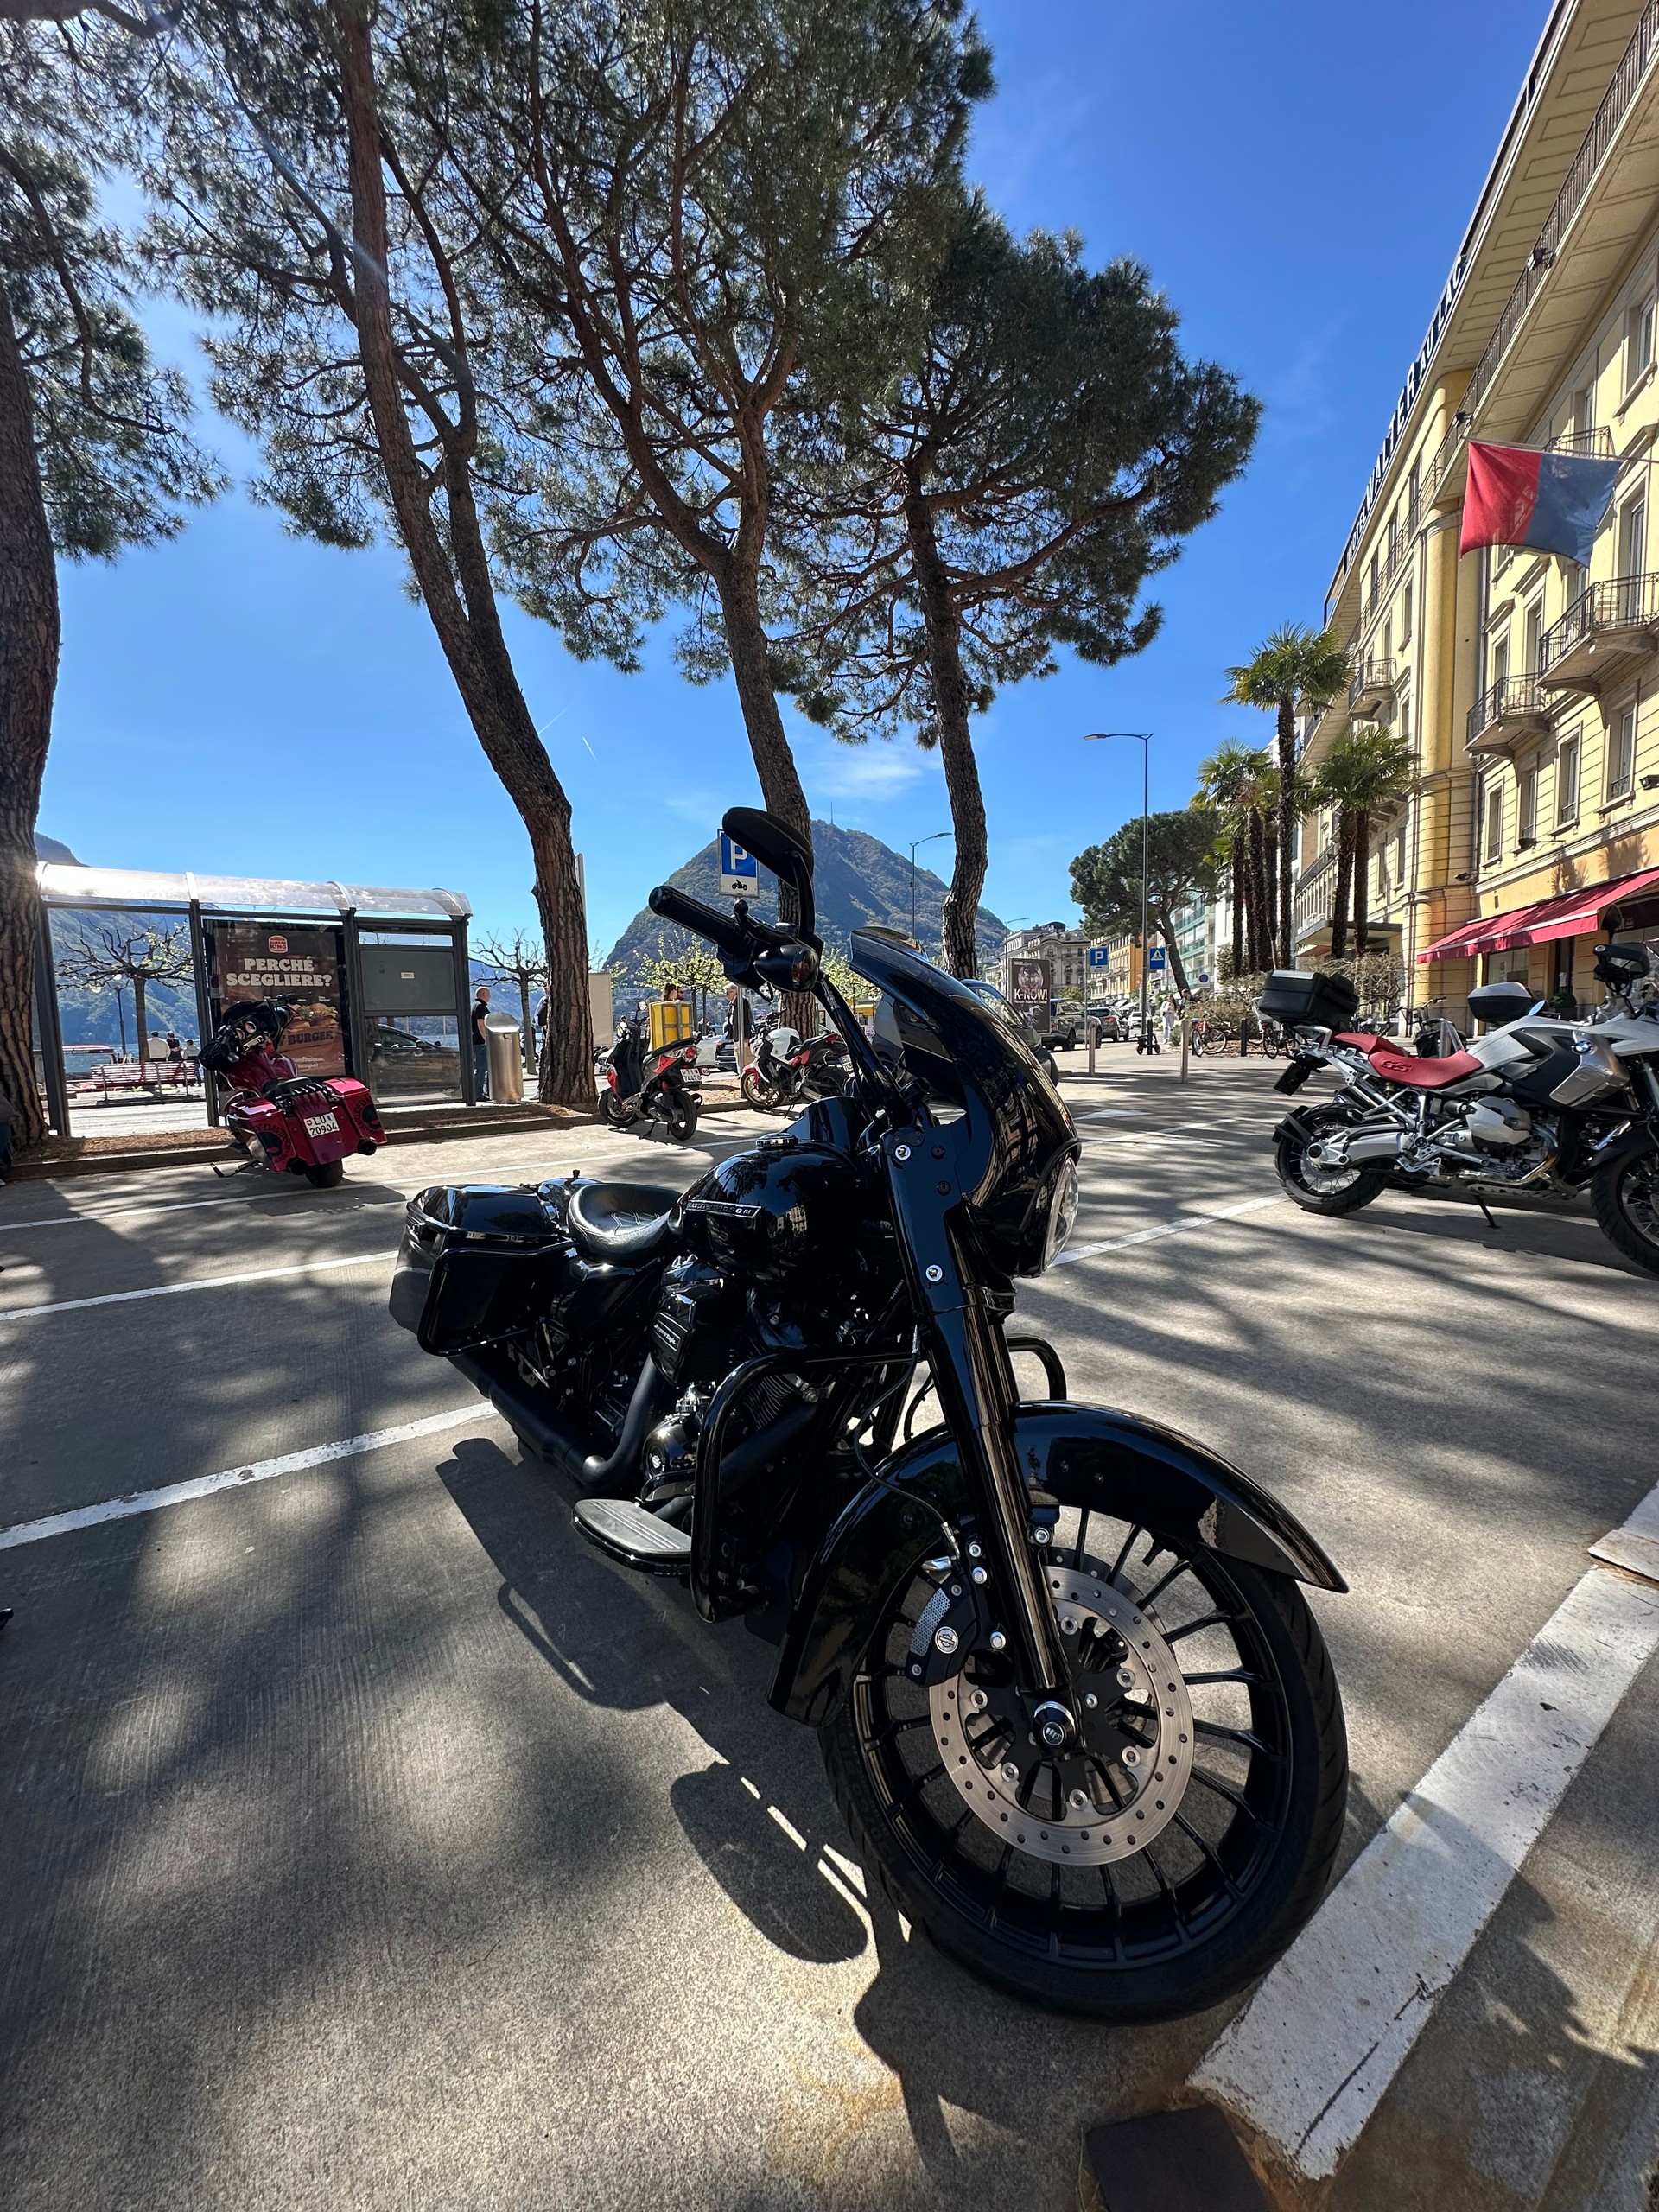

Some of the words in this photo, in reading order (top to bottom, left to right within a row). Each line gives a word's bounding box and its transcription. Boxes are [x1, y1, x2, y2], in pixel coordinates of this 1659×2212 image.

[1366, 360, 1416, 512] WALTER
[1420, 326, 1434, 380] AU
[1437, 255, 1463, 332] LAC
[730, 838, 748, 870] P
[244, 956, 315, 972] PERCHÉ
[1095, 950, 1104, 964] P
[226, 972, 333, 987] SCEGLIERE?
[1014, 988, 1048, 1001] K-NOW!
[288, 1030, 334, 1046] BURGER
[1381, 1059, 1413, 1072] GS
[314, 1115, 327, 1126] LU
[309, 1124, 338, 1137] 20904
